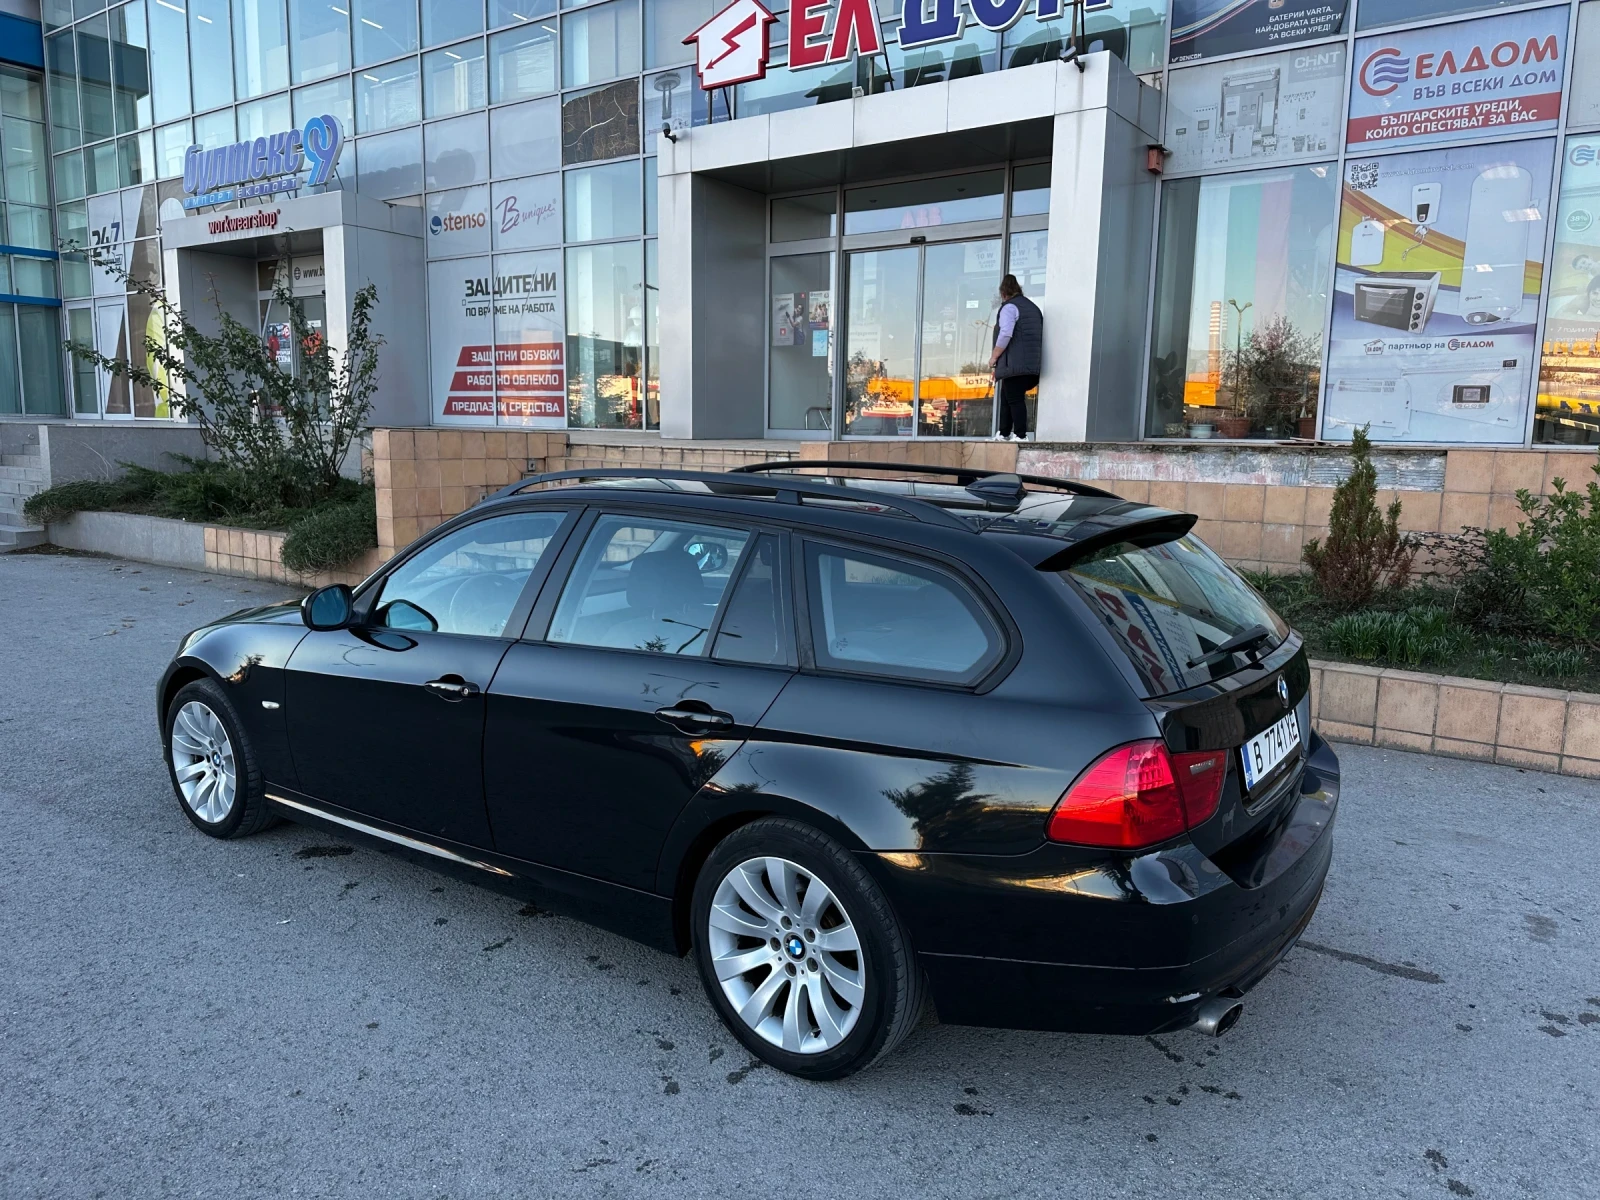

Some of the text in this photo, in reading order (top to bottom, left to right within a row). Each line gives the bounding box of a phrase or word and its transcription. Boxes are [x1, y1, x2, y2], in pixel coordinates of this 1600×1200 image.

[1269, 6, 1334, 23] БАТЕРИИ VARTA.
[1255, 19, 1309, 34] НАЙ-ДОБРАТА
[1268, 24, 1331, 41] ЗА ВСЕКИ УРЕД!
[1414, 35, 1559, 80] ЕЛДОМ
[1413, 69, 1557, 101] ВЪВ ВСЕКИ ДОМ
[1380, 99, 1523, 127] БЪЛГАРСКИТЕ УРЕДИ,
[1365, 109, 1538, 140] КОИТО СПЕСТЯВАТ ЗА ВАС
[208, 210, 278, 235] workwearshop
[443, 212, 486, 232] stenso
[465, 272, 557, 298] ЗАЩИТЕНИ
[465, 307, 477, 317] ПО
[508, 304, 520, 315] НА
[521, 303, 556, 316] РАБОТА
[1388, 342, 1432, 351] партньор
[1461, 340, 1494, 348] ЕЛДОМ
[520, 349, 560, 361] ОБУВКИ
[512, 374, 559, 386] ОБЛЕКЛО
[509, 401, 560, 413] СРЕДСТВА
[1252, 741, 1264, 774] B
[1264, 722, 1287, 765] 7741
